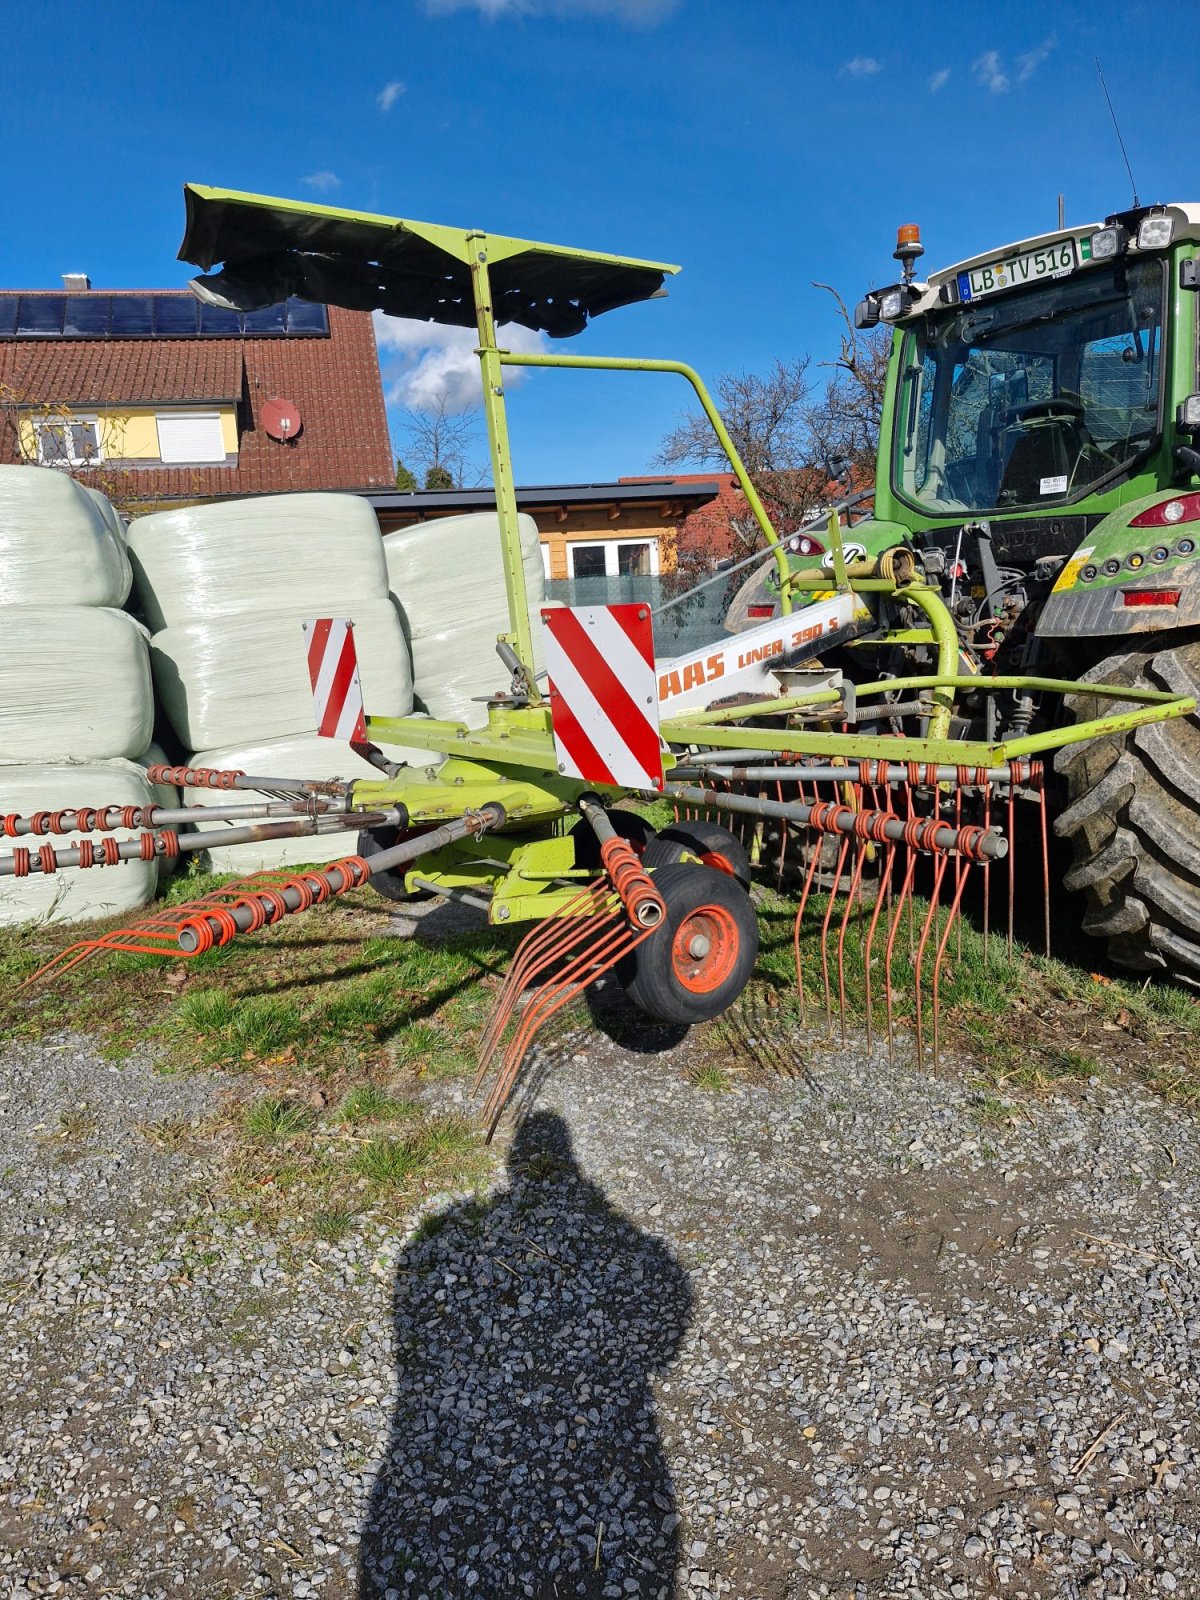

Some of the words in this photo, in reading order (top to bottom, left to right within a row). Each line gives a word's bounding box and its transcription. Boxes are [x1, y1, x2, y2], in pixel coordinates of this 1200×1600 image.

[970, 269, 994, 293] LB
[1006, 257, 1029, 282] TV
[1035, 245, 1071, 274] 516
[659, 652, 725, 702] AAS
[738, 638, 784, 669] LINER
[791, 622, 823, 648] 390
[829, 616, 839, 634] S
